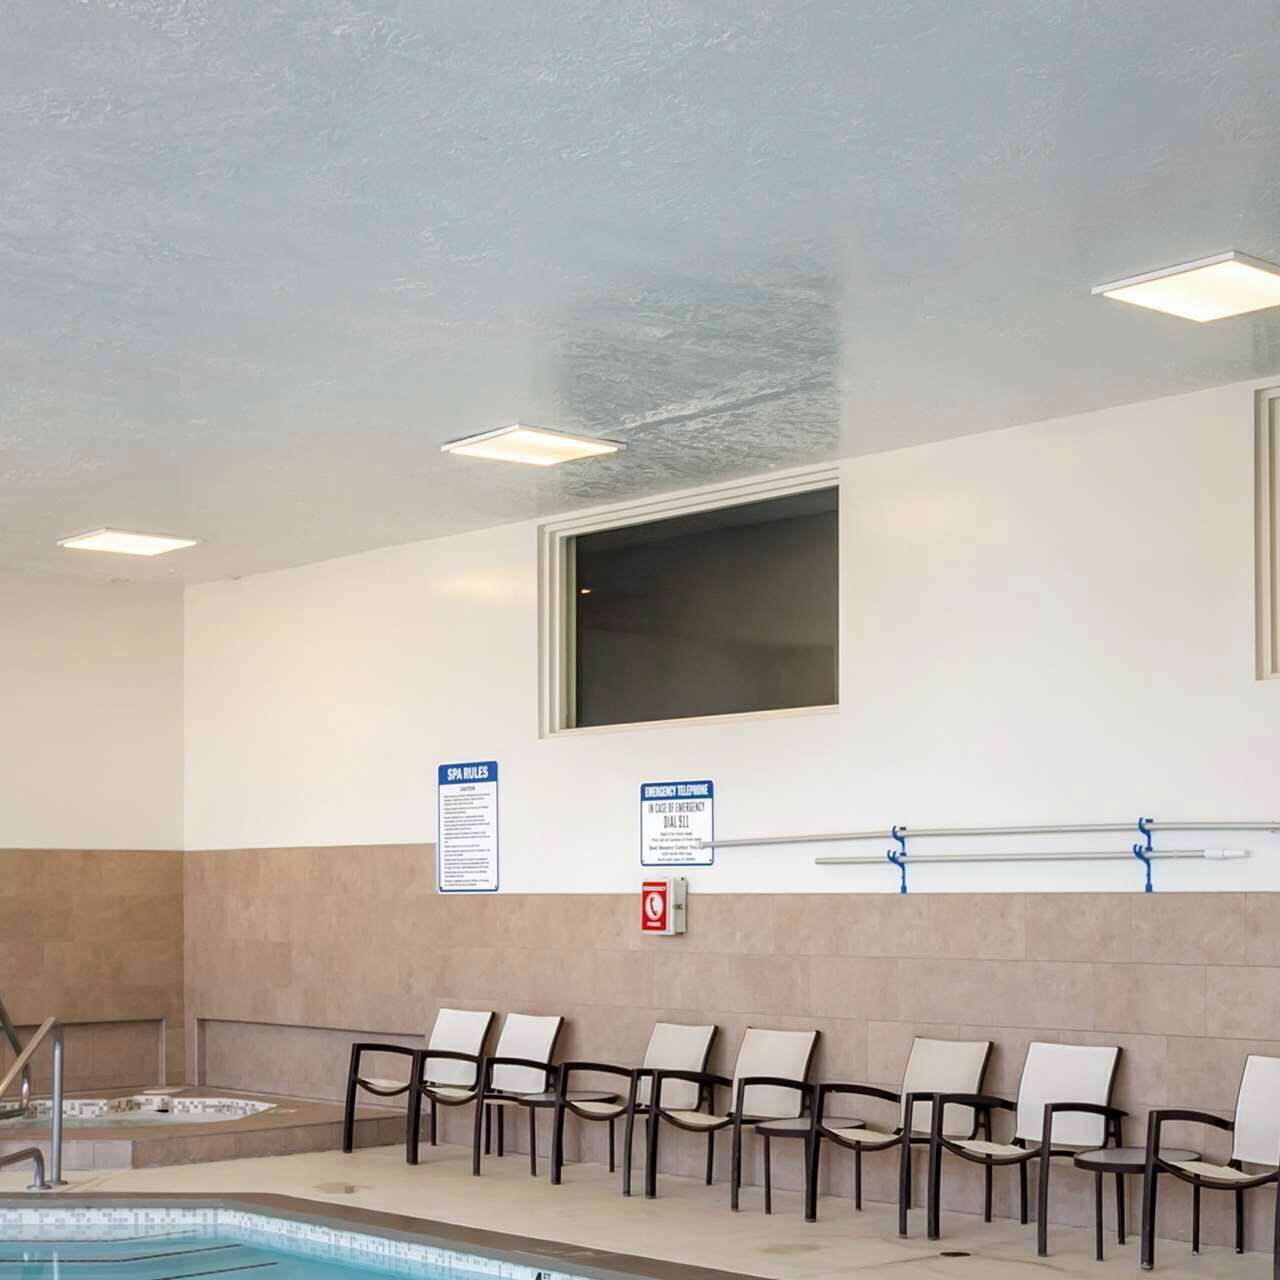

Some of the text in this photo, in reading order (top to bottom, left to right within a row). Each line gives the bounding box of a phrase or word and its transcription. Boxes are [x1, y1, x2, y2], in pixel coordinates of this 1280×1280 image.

[448, 766, 489, 780] SPA RULES
[645, 784, 709, 798] EMERGENCY TELEPHONE
[648, 801, 705, 814] IN CASE OF EMERGENCY
[664, 814, 689, 829] DIAL 911
